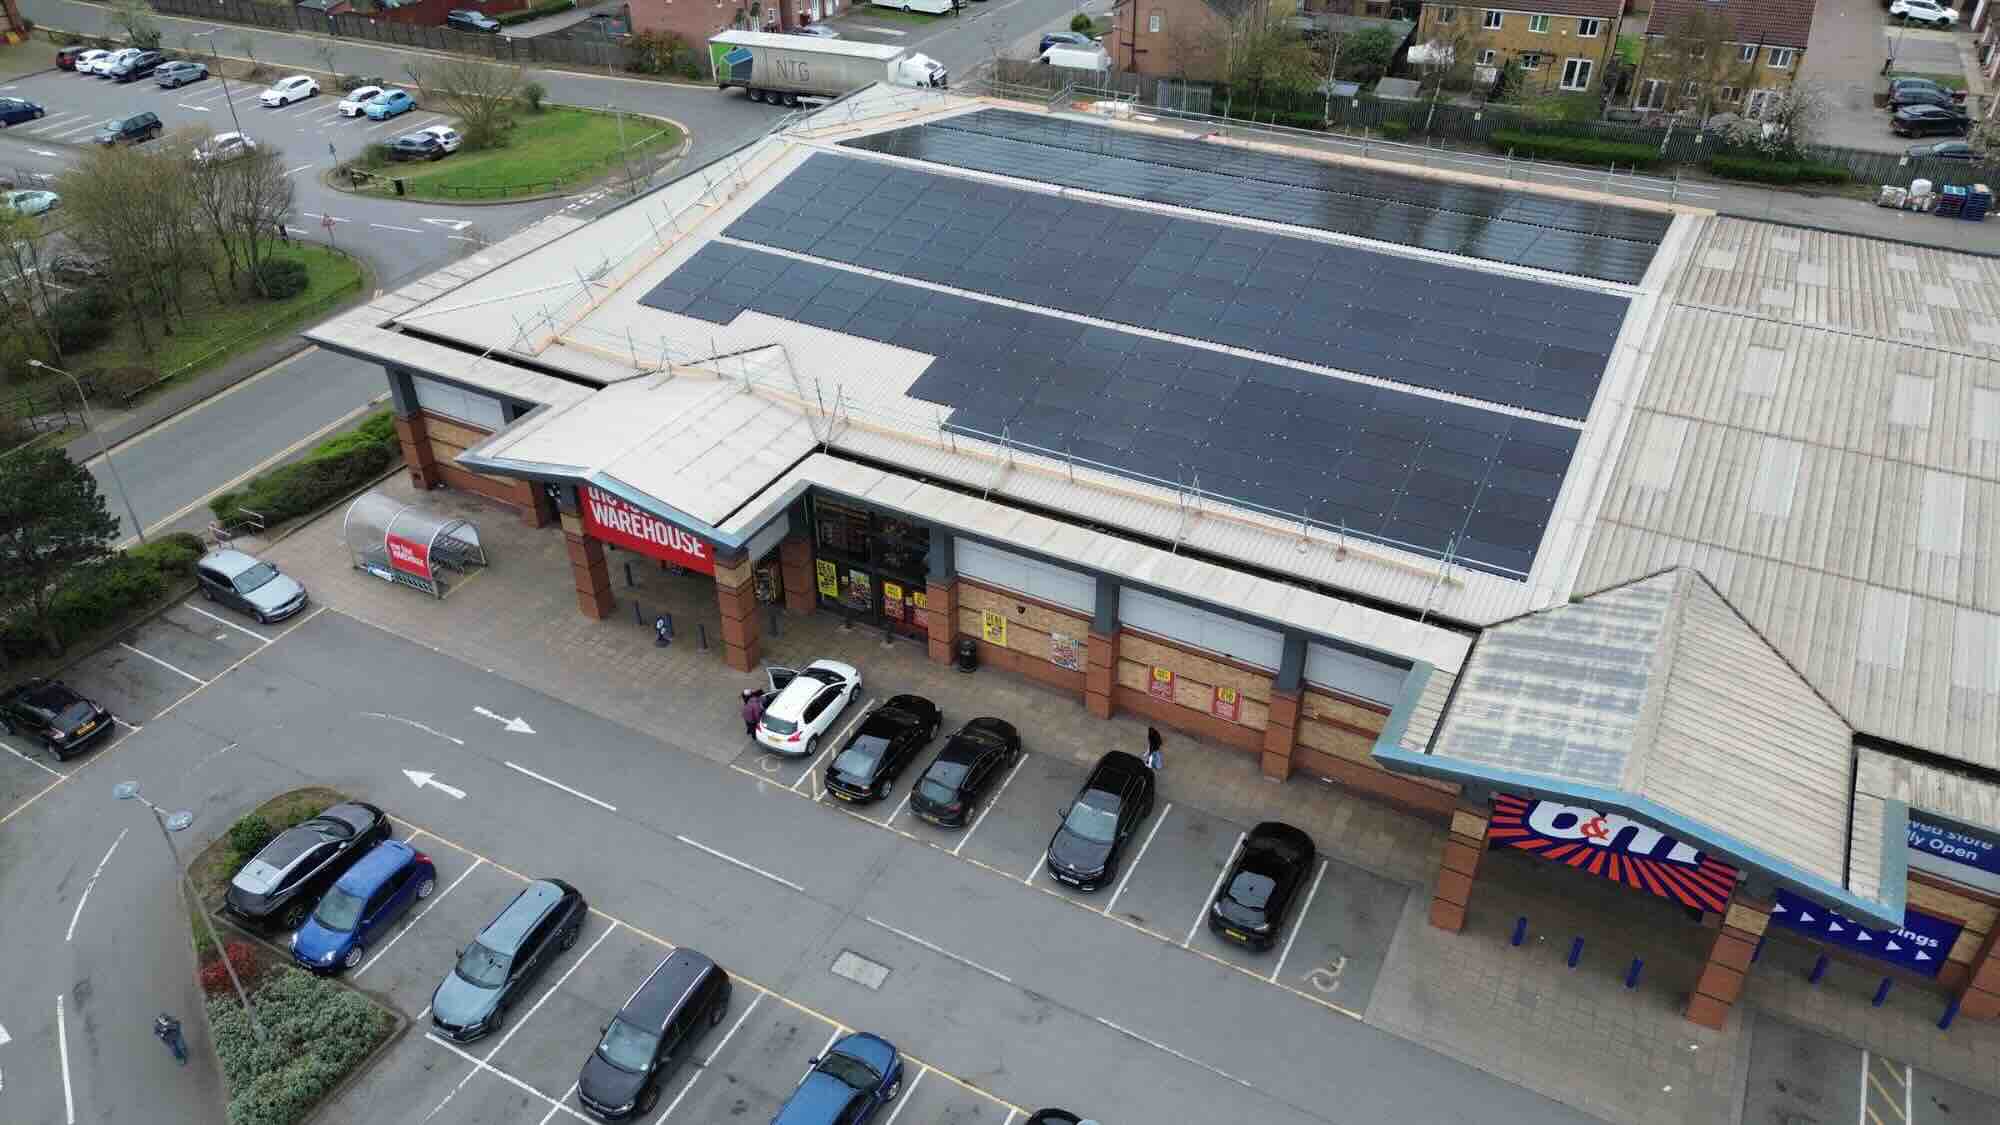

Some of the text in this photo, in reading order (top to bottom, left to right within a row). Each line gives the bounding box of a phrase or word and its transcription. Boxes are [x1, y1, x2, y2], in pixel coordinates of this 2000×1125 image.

[775, 59, 810, 81] NTG
[589, 500, 706, 559] WAREHOUSE
[1929, 838, 1977, 860] Open
[1887, 926, 1939, 947] ings
